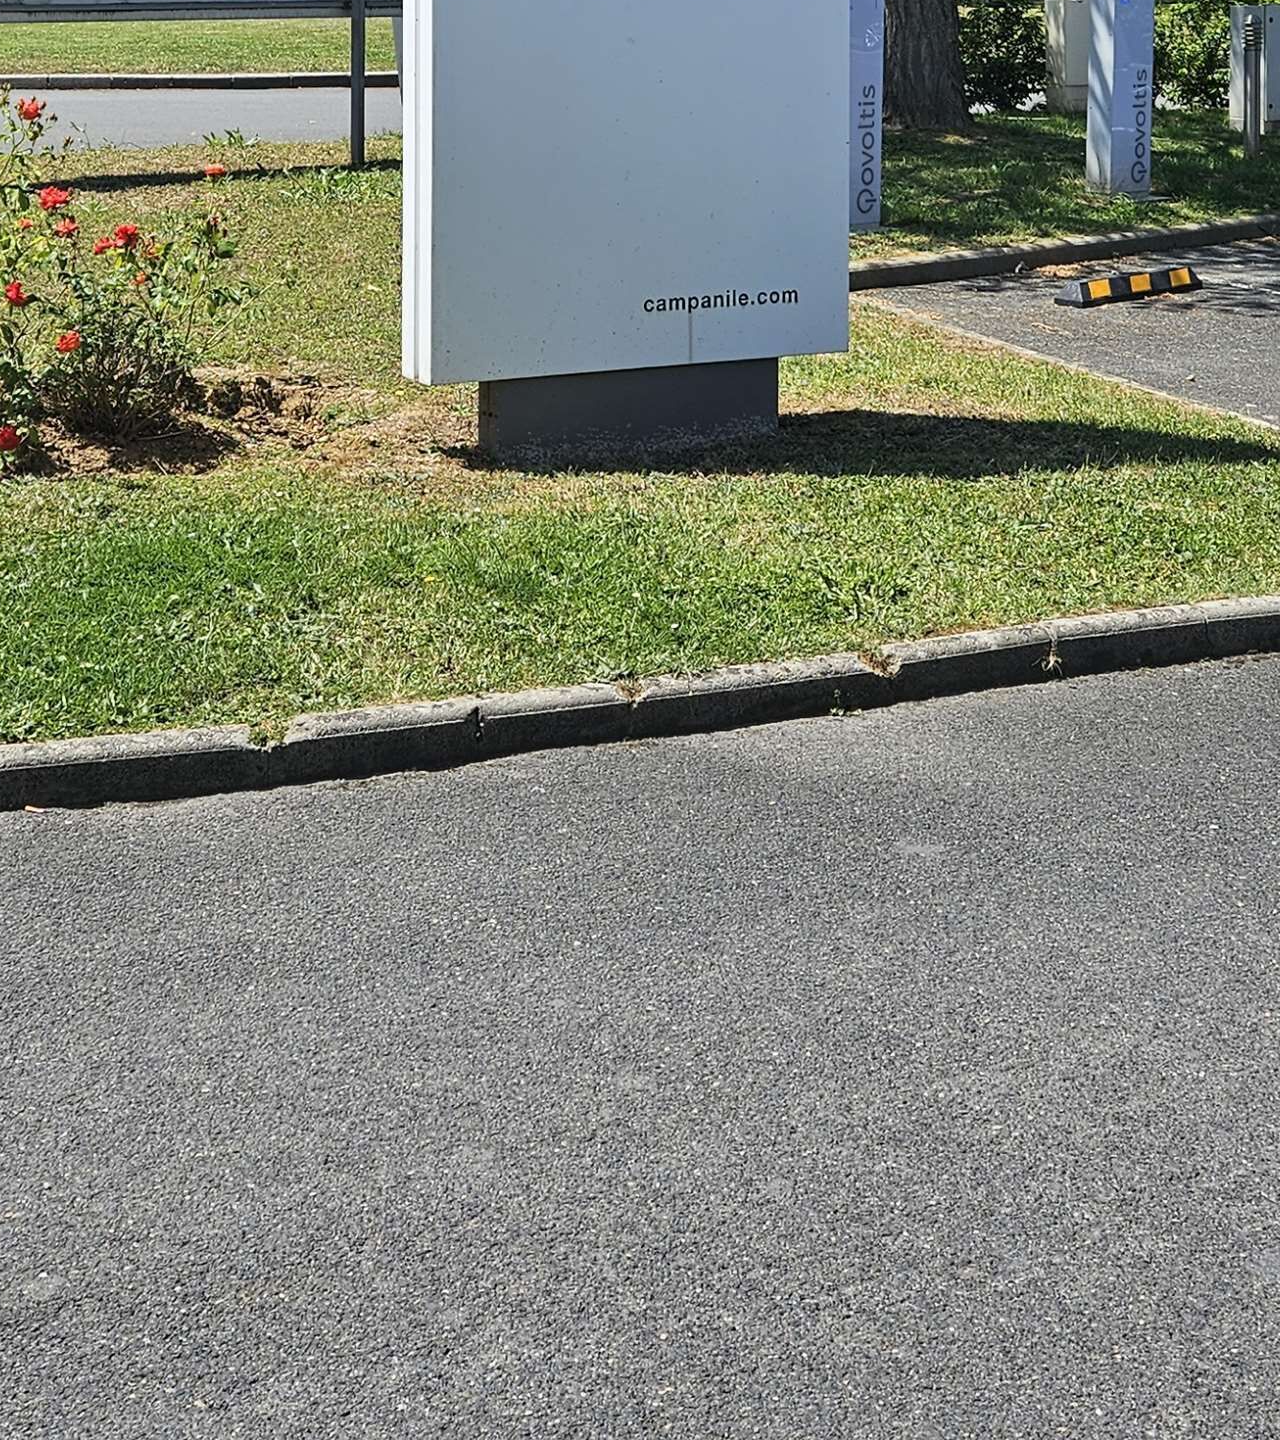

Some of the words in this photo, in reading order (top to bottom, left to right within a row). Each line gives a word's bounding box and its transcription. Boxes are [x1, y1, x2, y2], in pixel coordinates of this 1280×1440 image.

[856, 84, 877, 214] Qovoltis
[1130, 68, 1148, 184] Qovoltis
[643, 288, 799, 313] campanile.com
